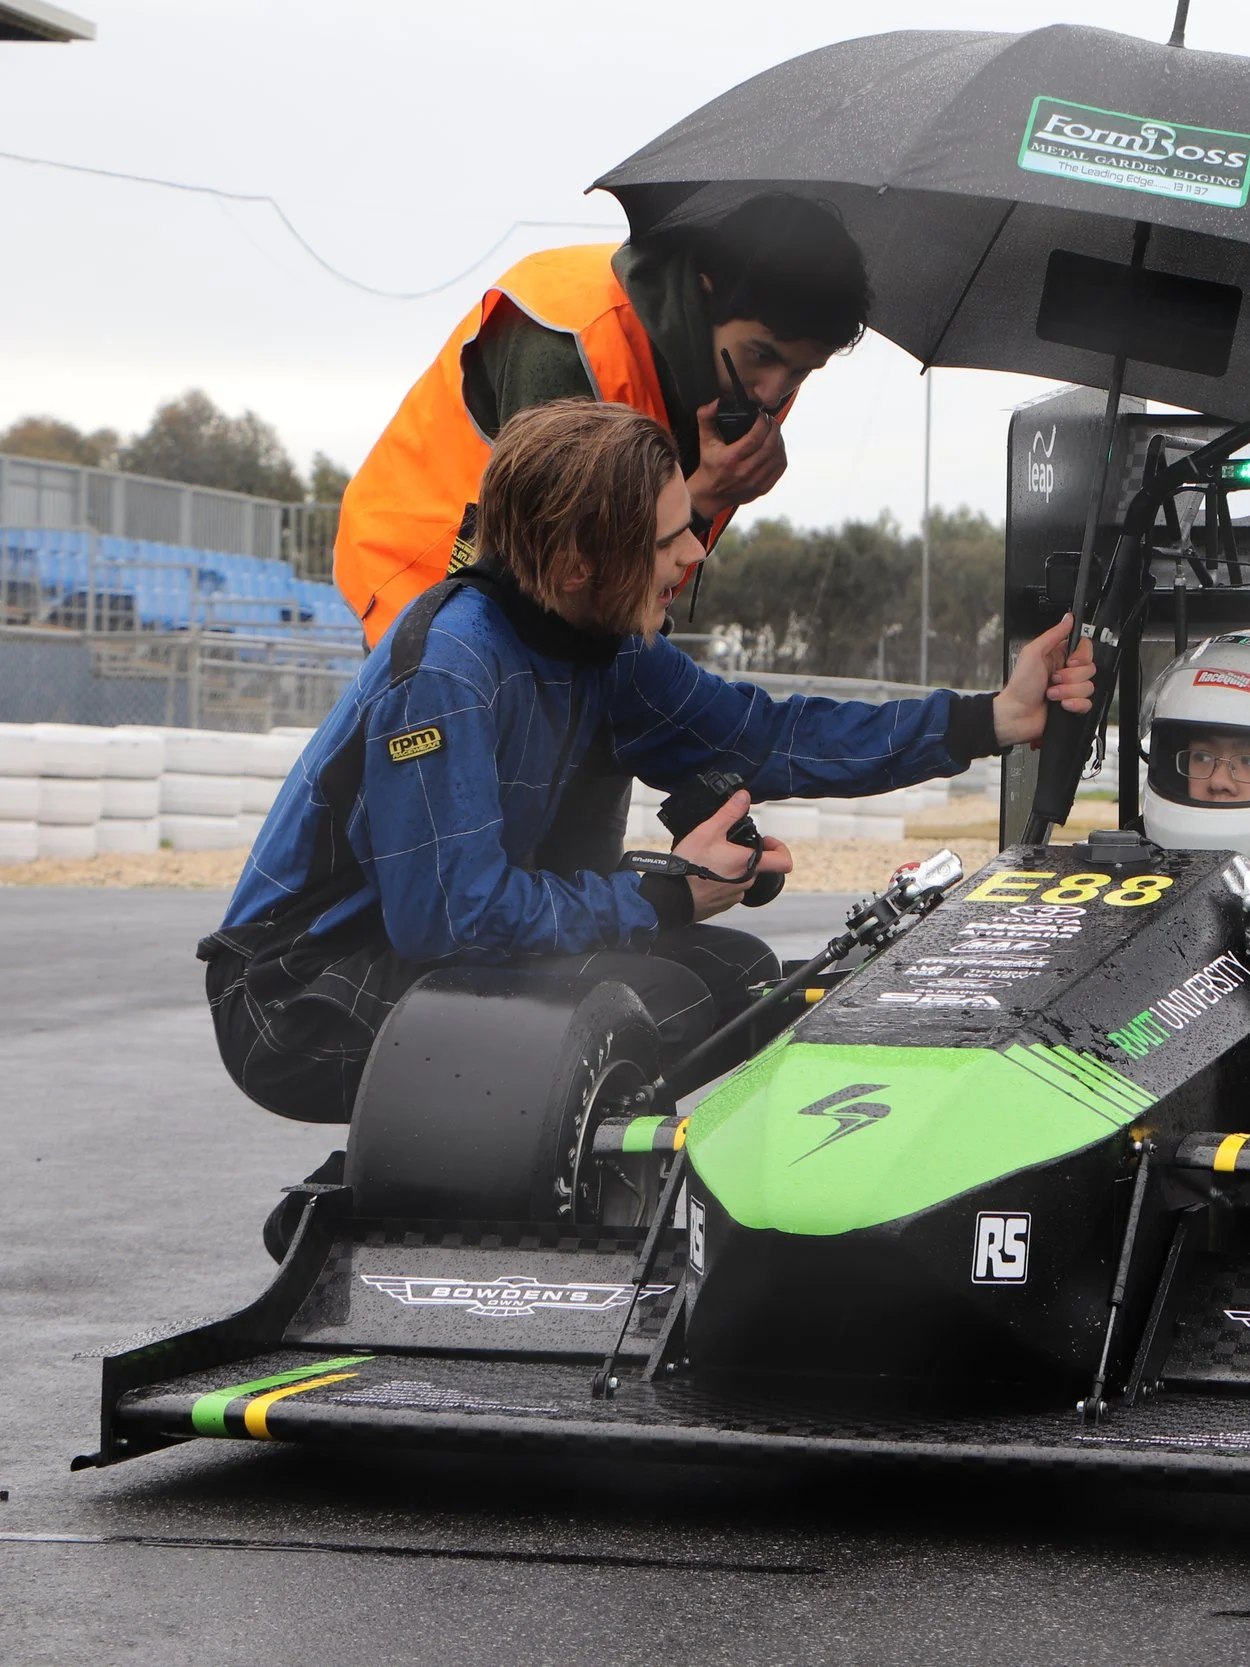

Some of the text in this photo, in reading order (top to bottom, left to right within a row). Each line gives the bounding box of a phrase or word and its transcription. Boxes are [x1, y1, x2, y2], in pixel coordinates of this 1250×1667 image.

[1030, 141, 1242, 189] METAL GARDEN EDGING
[1058, 160, 1079, 173] The
[1081, 163, 1124, 184] Leading
[1173, 181, 1185, 192] 13
[1194, 185, 1209, 196] 37
[1028, 451, 1054, 504] leap
[392, 730, 436, 753] rpm
[631, 855, 668, 866] OLYMPUS
[961, 870, 1174, 907] E88
[991, 916, 1083, 926] TOYOTA
[1107, 1010, 1172, 1060] RMIT
[975, 1217, 1028, 1278] RS
[430, 1286, 590, 1302] BOWDEN'S
[486, 1299, 525, 1307] OWN
